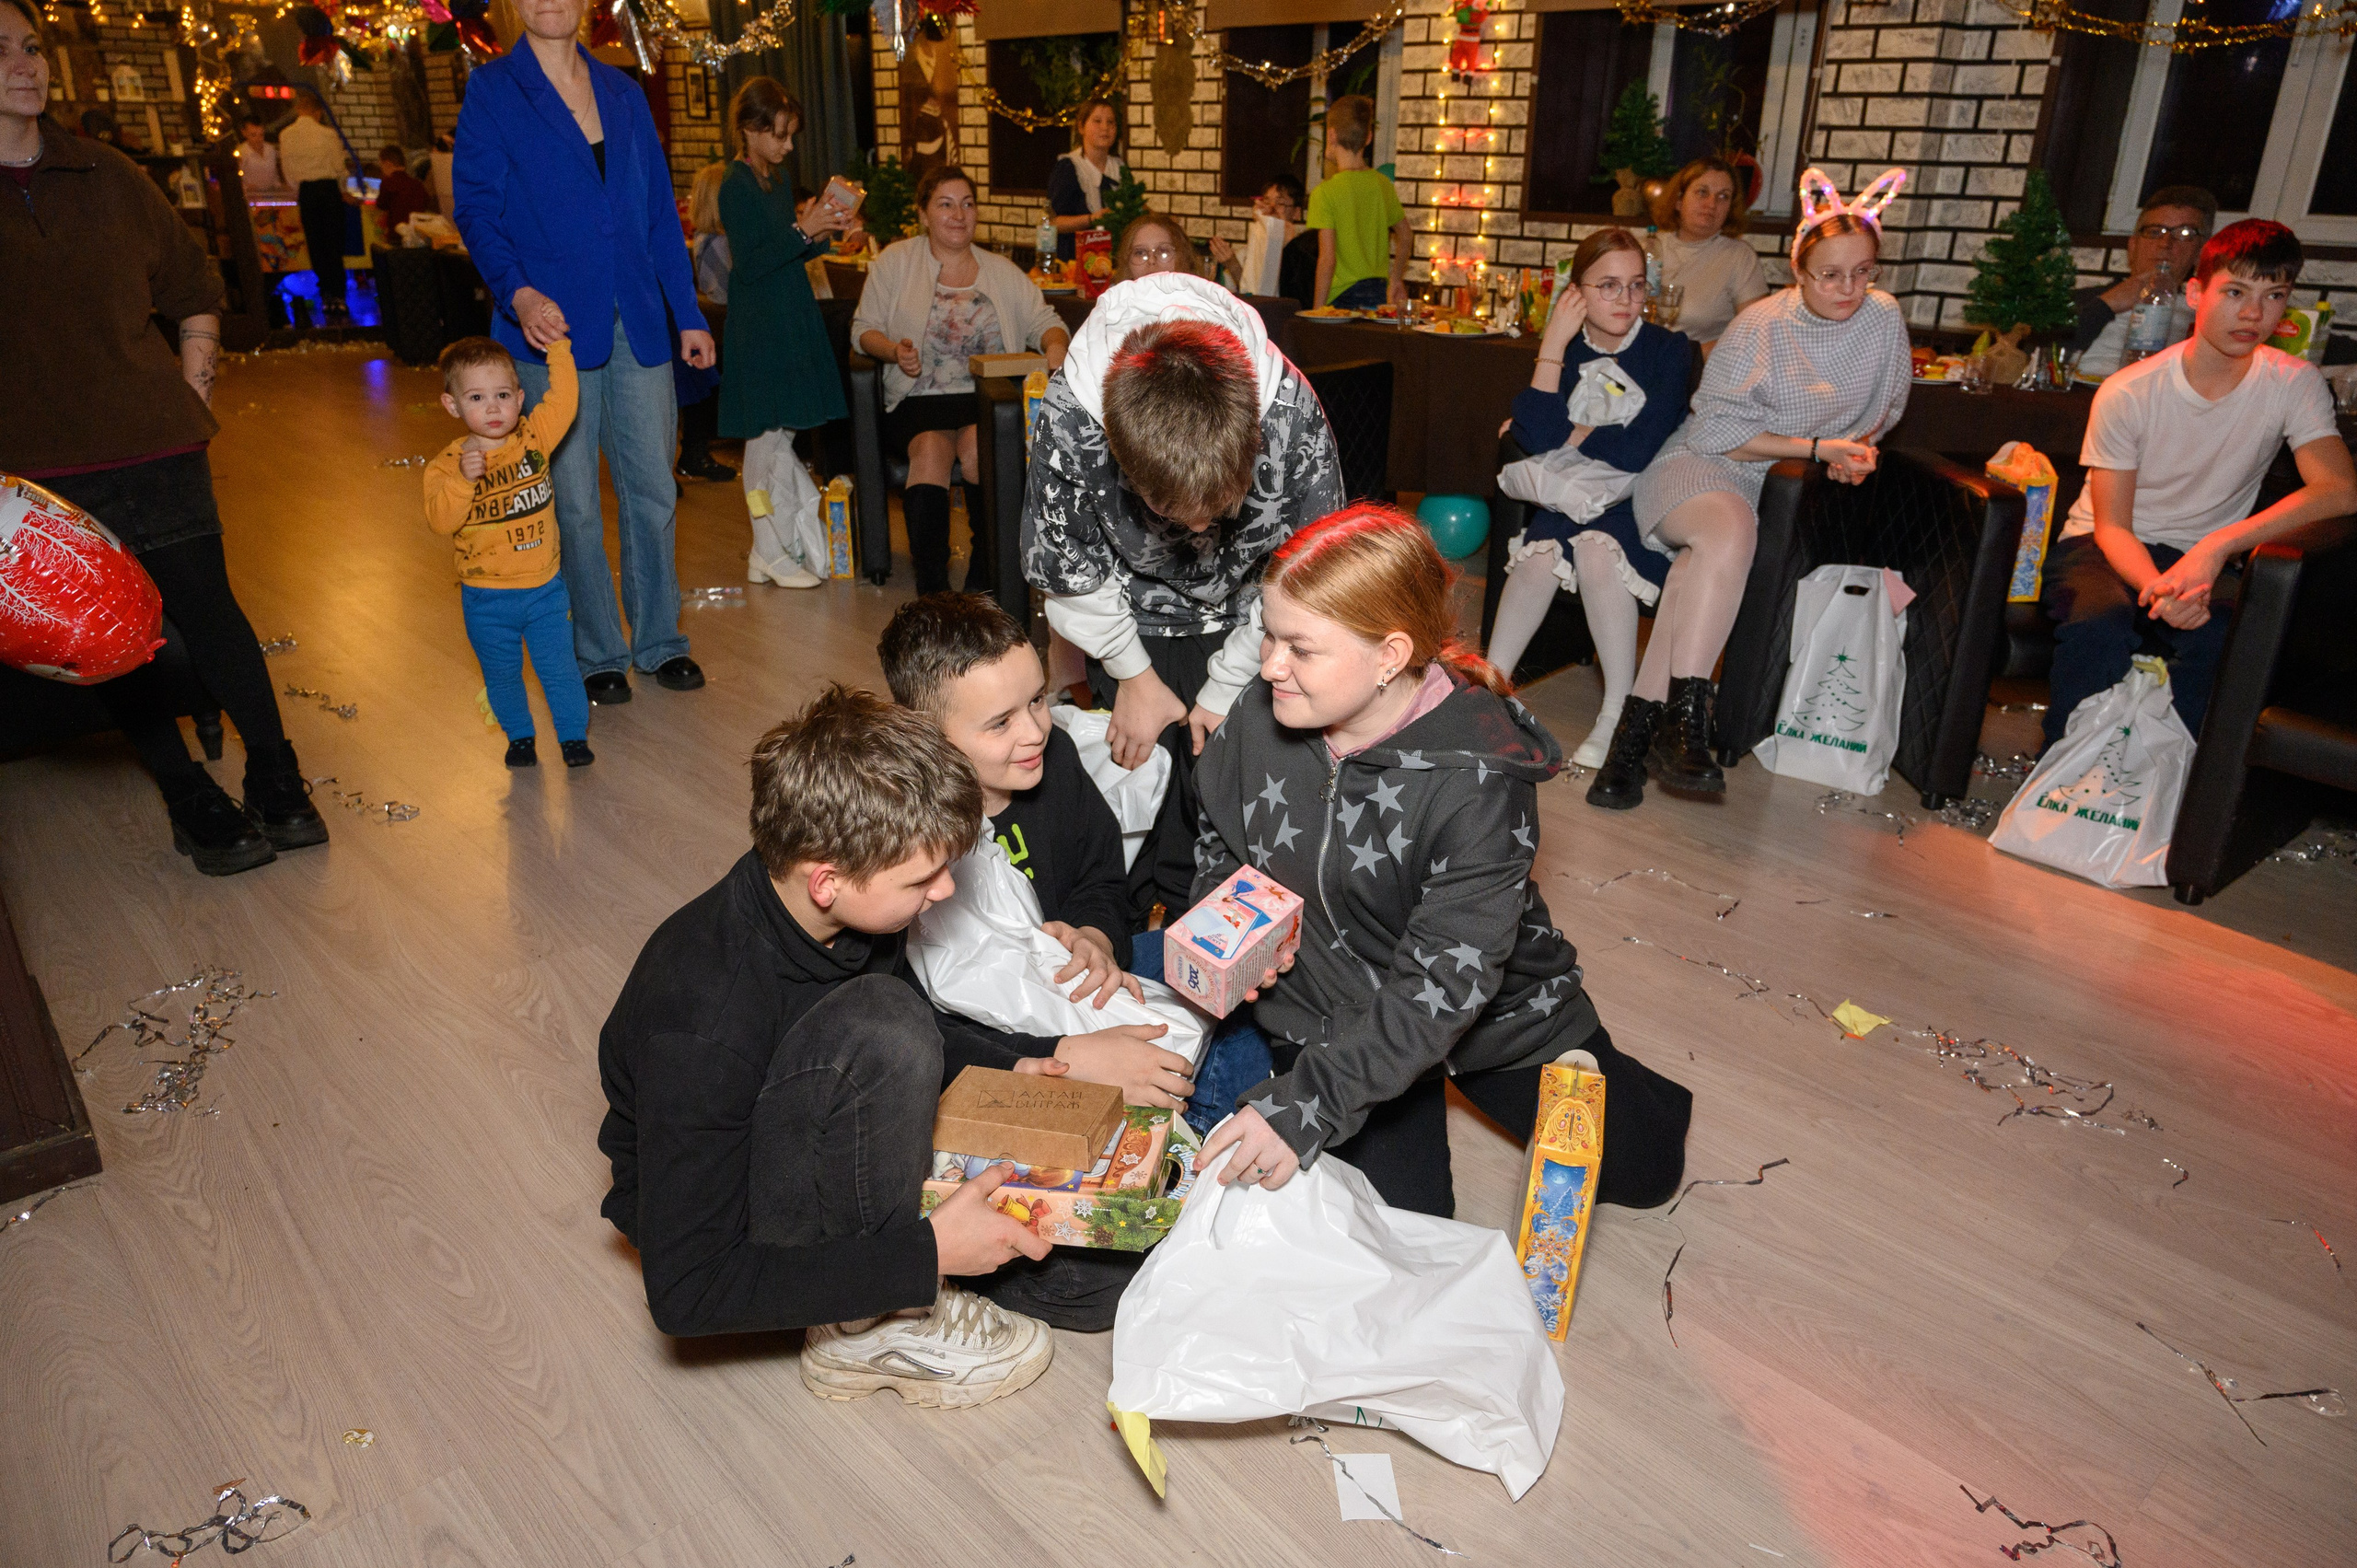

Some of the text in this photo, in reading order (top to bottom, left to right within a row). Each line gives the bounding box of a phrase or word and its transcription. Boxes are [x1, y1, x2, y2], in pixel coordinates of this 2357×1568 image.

[466, 476, 552, 522] NBEATABLE
[506, 520, 545, 543] 1972
[1188, 964, 1201, 993] 2026
[1016, 1100, 1080, 1109] ВИТРАЖ
[916, 1345, 946, 1360] FILA
